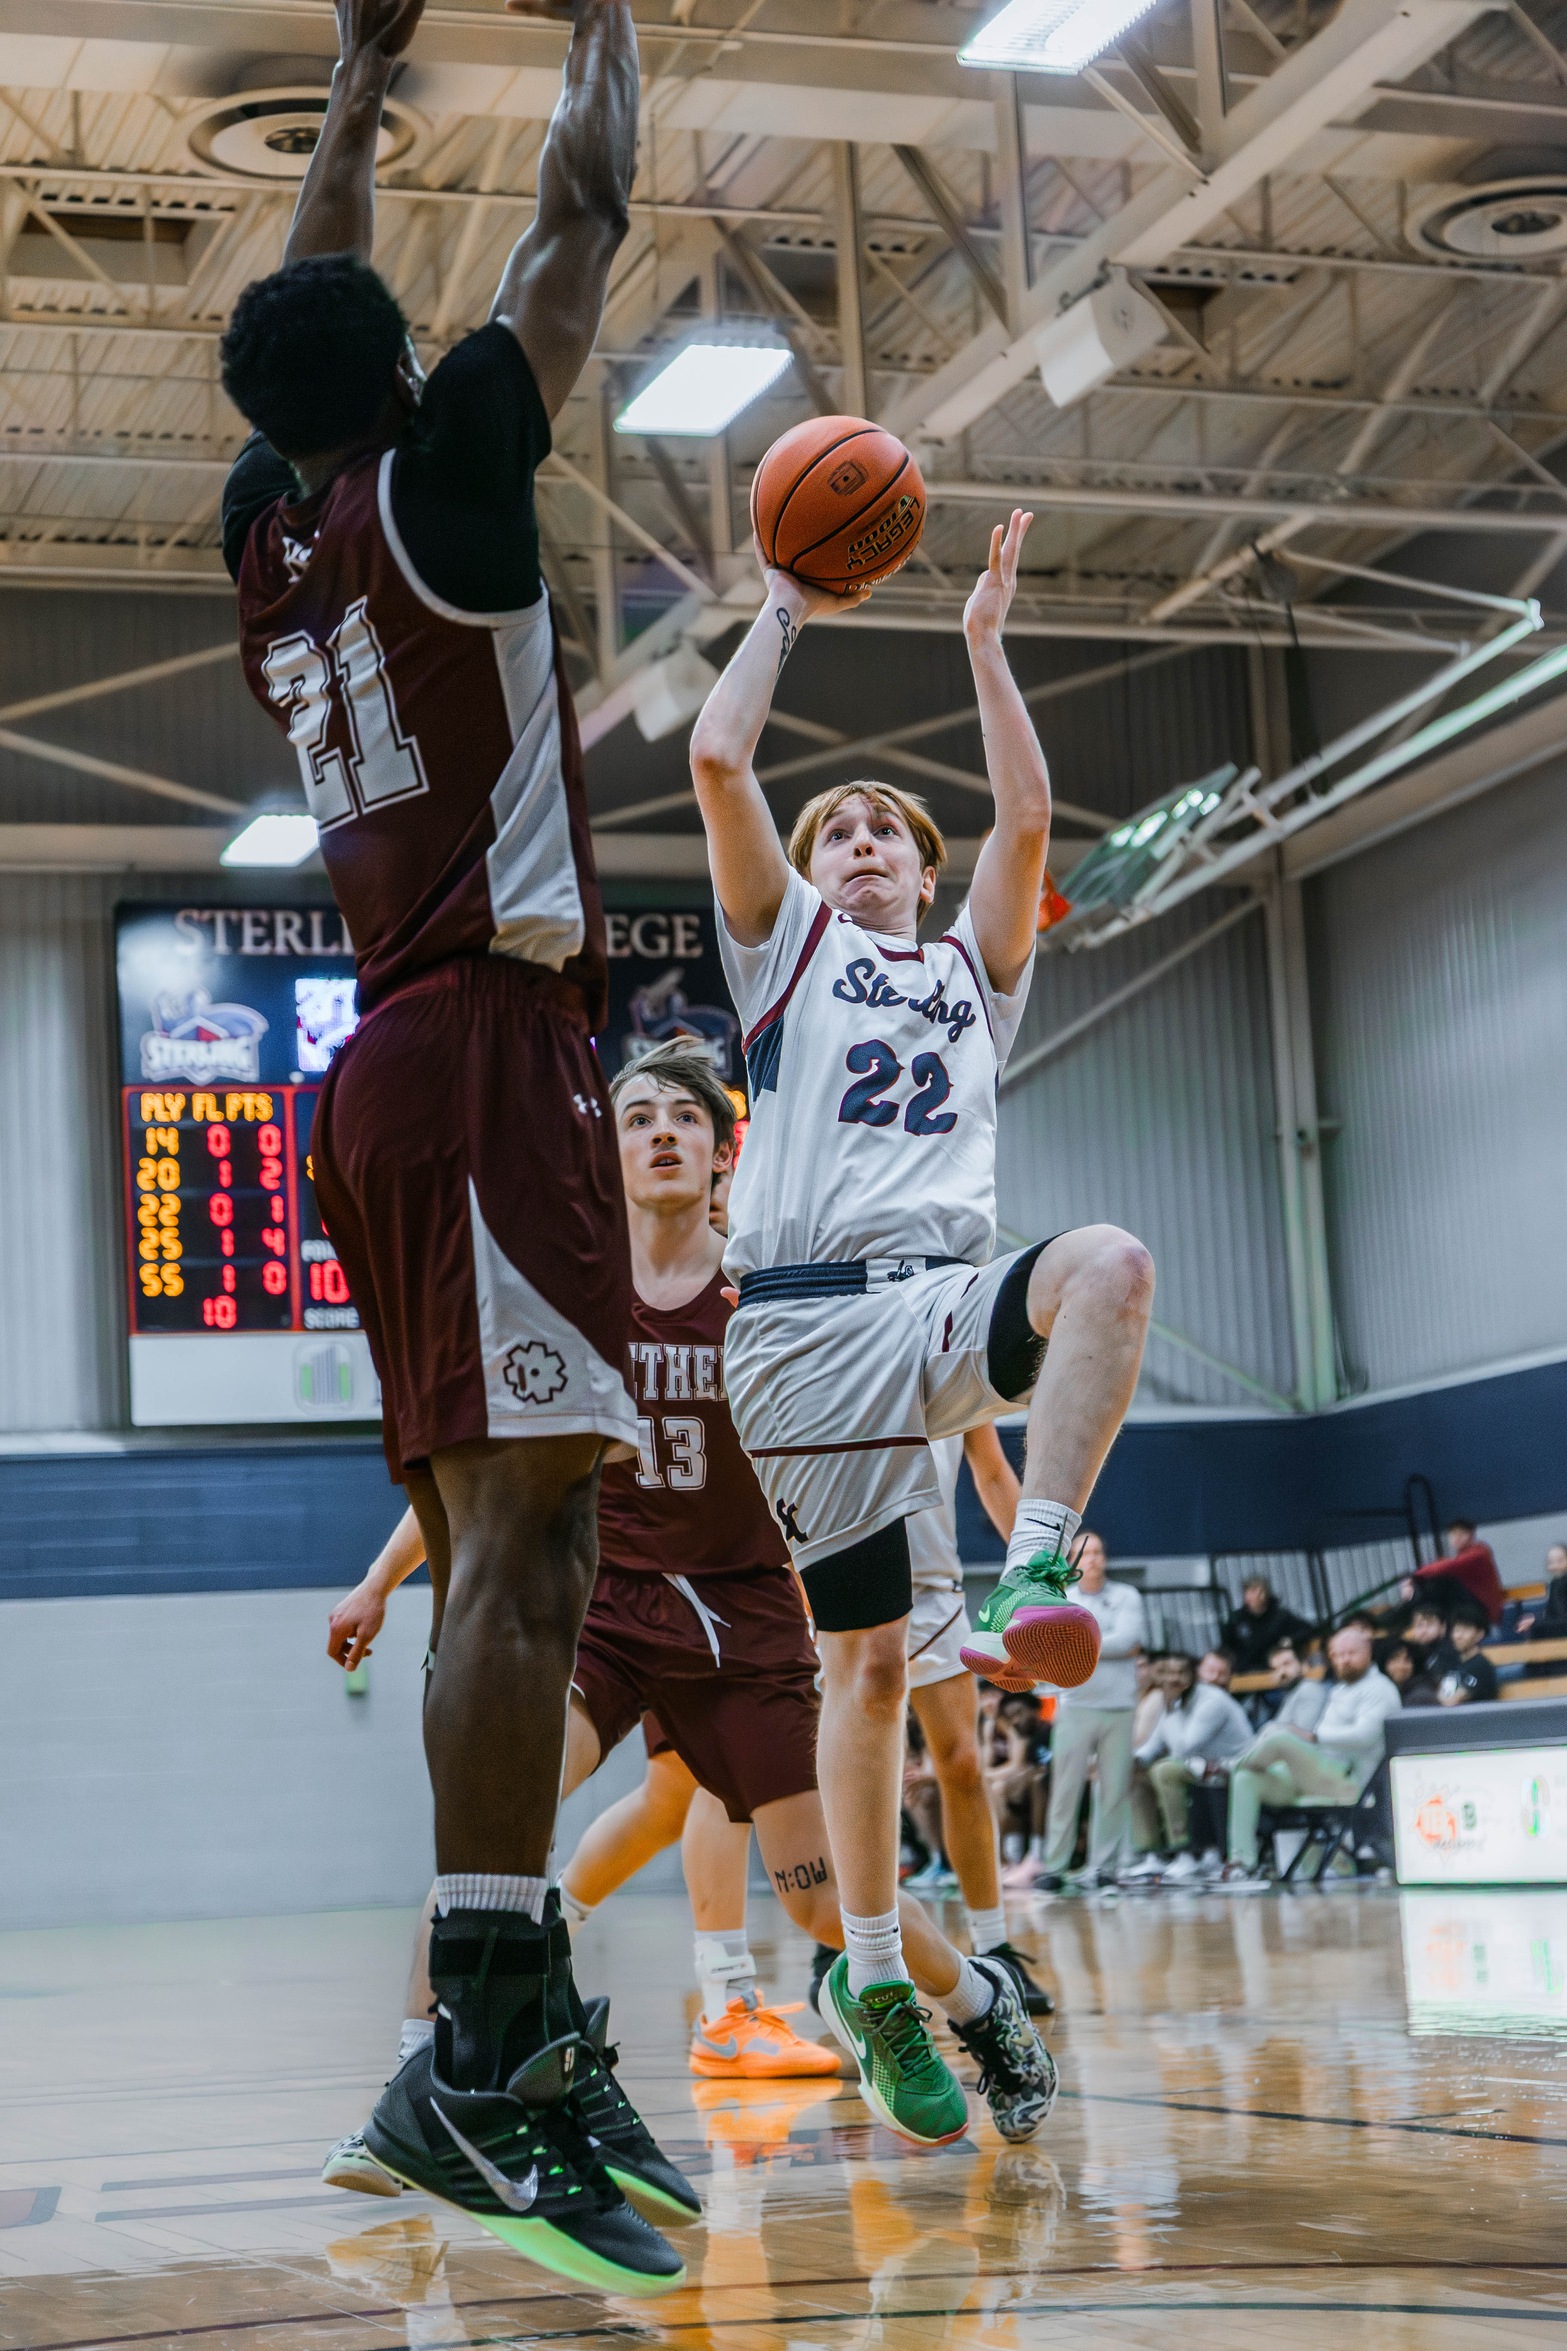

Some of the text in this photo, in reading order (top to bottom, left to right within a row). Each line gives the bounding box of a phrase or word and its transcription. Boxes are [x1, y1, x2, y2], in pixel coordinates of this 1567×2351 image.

[846, 496, 920, 571] LEGACY
[261, 595, 430, 835] 21
[838, 1039, 959, 1137] 22
[146, 1123, 282, 1157] 14 0 0
[136, 1157, 181, 1191] 20
[219, 1159, 232, 1188] 1
[259, 1157, 283, 1191] 2
[137, 1192, 284, 1227] 22 0 1
[138, 1227, 183, 1260] 25
[221, 1228, 234, 1257] 1
[261, 1227, 285, 1257] 4
[139, 1260, 287, 1297] 55 1 0
[309, 1259, 350, 1303] 10
[203, 1295, 237, 1329] 10
[635, 1416, 708, 1491] 13
